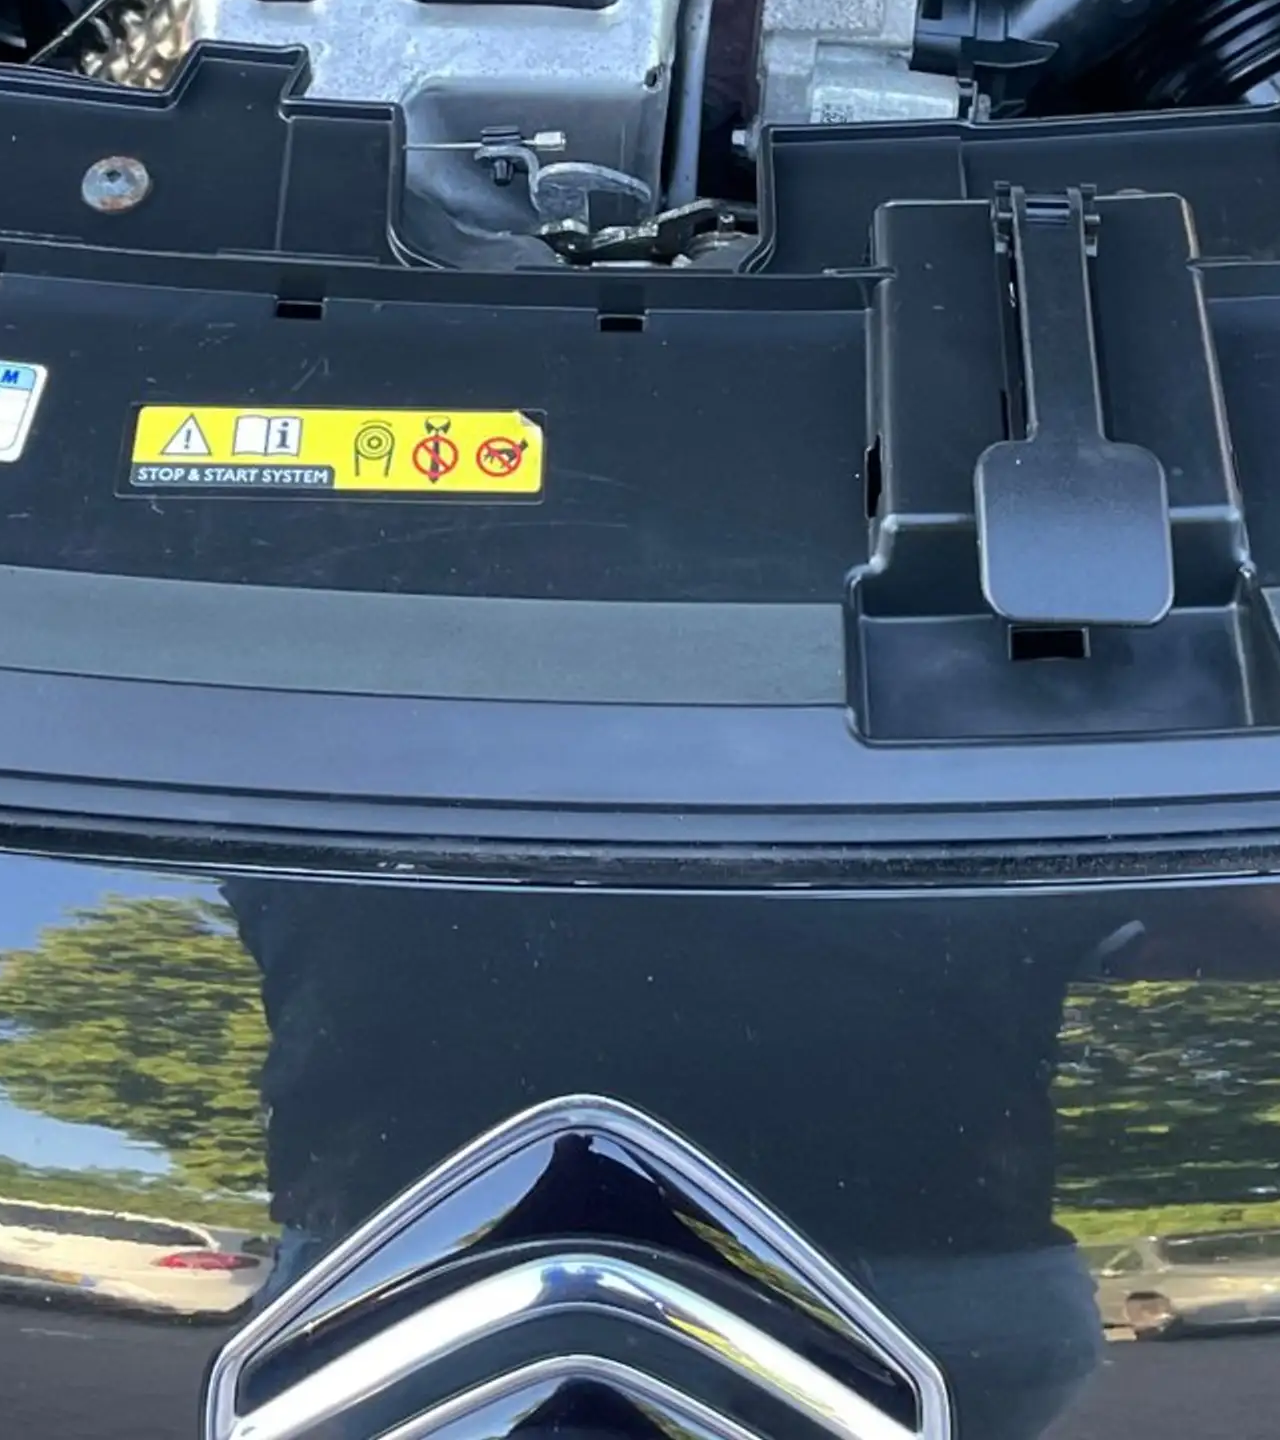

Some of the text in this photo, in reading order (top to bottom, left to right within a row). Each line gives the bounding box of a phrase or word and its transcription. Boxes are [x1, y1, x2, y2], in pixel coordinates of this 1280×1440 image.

[137, 466, 329, 485] STOP & START SYSTEM
